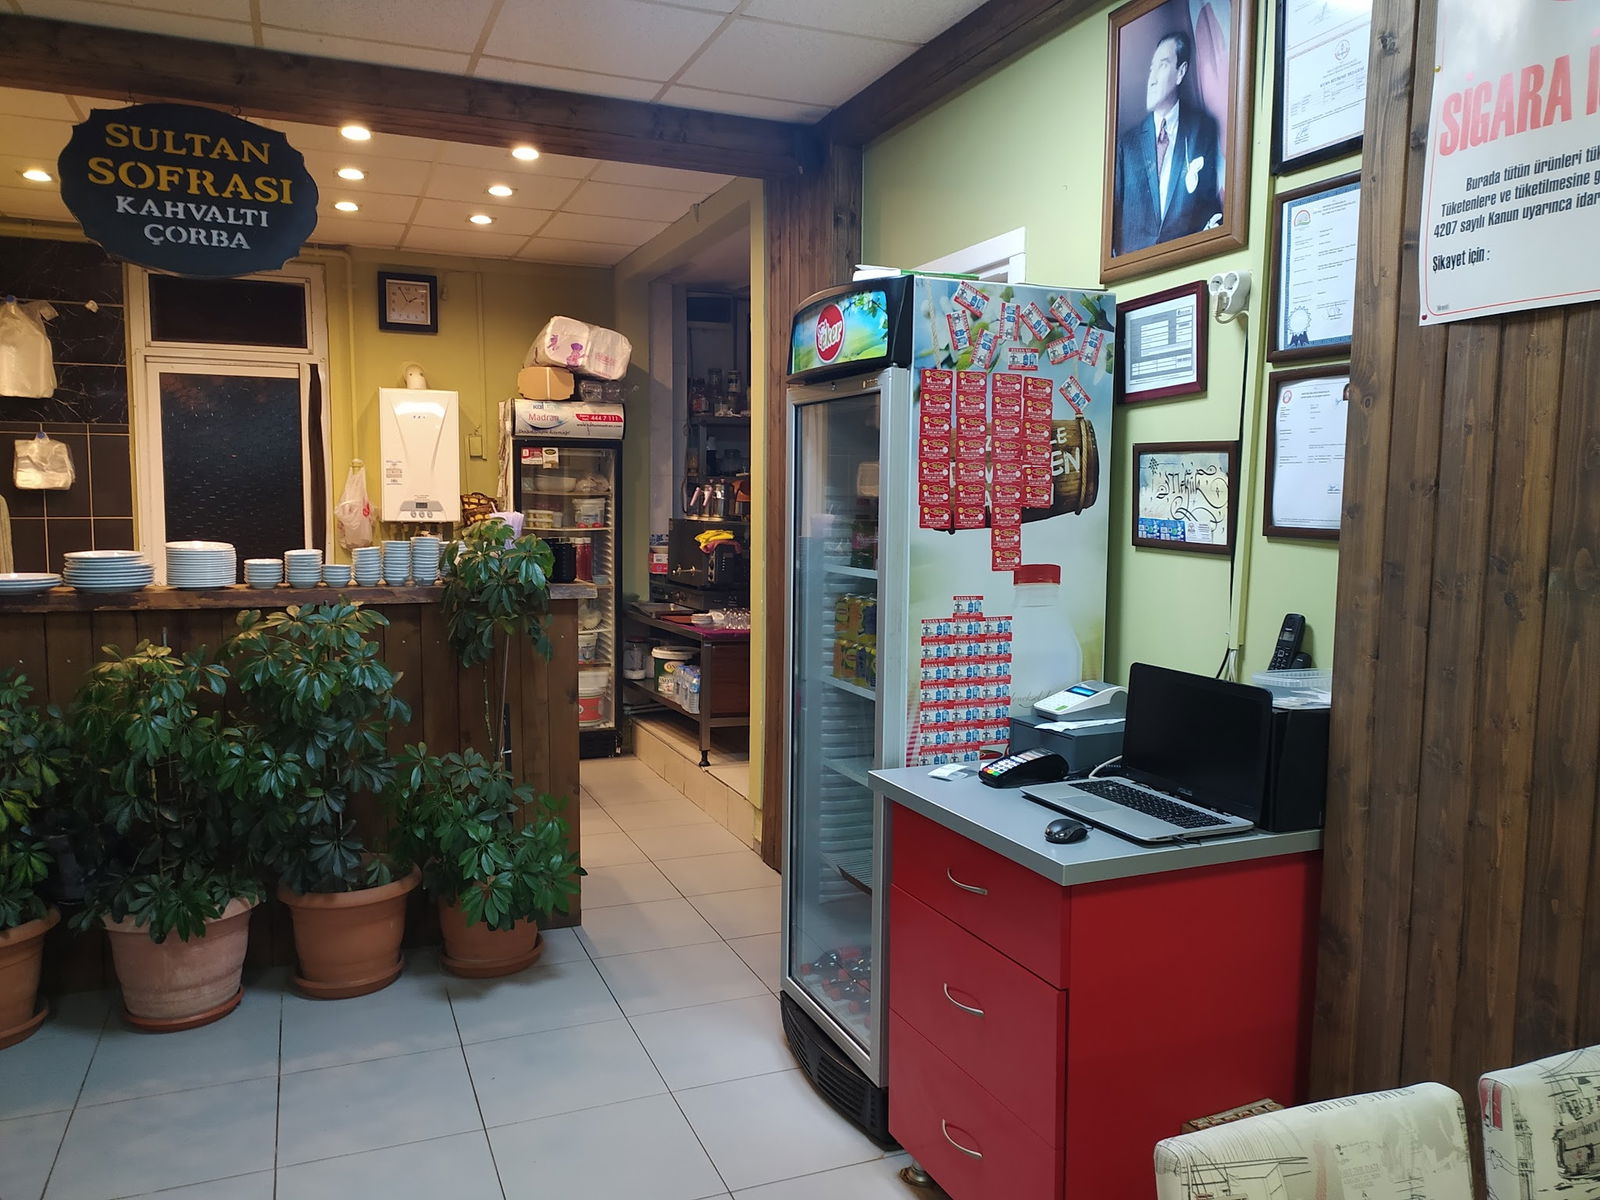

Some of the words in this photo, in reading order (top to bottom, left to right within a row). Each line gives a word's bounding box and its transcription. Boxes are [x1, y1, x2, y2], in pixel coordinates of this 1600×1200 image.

[1439, 54, 1572, 156] SİGARA
[105, 122, 270, 165] SULTAN
[87, 156, 294, 205] SOFRASI
[1466, 170, 1501, 192] Burada
[1504, 163, 1530, 182] tütün
[1534, 150, 1582, 175] ürünleri
[115, 195, 269, 228] KAHVALTI
[1441, 193, 1496, 217] Tüketenlere
[1500, 189, 1512, 203] ve
[1514, 172, 1591, 200] tüketilmesine
[144, 223, 251, 250] ÇORBA
[1433, 220, 1458, 238] 4207
[1460, 214, 1486, 233] sayılı
[1488, 208, 1519, 227] Kanun
[1522, 198, 1573, 221] uyarınca
[1432, 249, 1466, 274] Şikayet
[1468, 246, 1485, 266] için
[528, 413, 559, 422] Madran
[1304, 1098, 1358, 1113] UNITED
[1362, 1088, 1416, 1103] STATES
